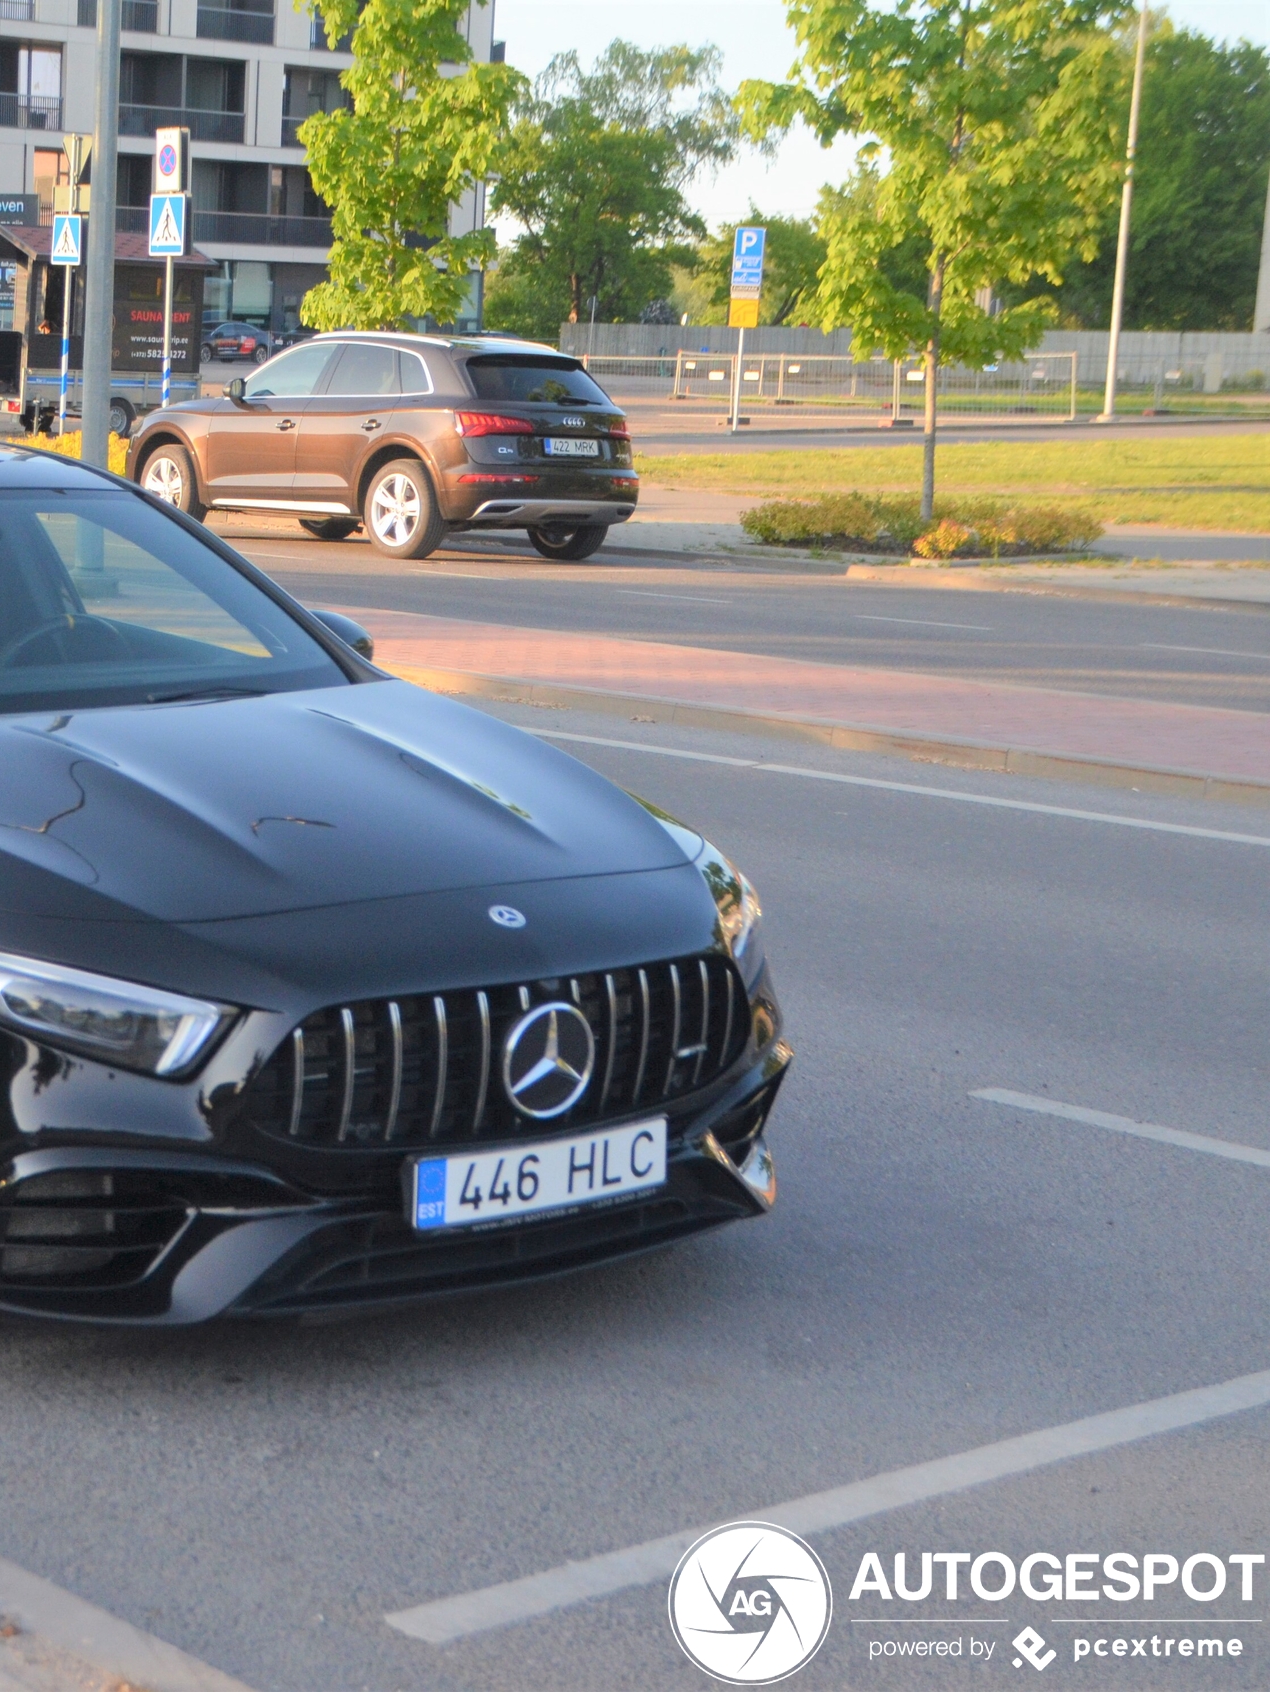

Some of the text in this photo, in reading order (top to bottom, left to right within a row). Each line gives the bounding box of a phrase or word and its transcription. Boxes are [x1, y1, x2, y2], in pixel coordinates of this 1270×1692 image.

[740, 231, 758, 255] P
[131, 310, 191, 323] SAUNA ENT
[131, 335, 189, 346] www.saunrip.ee
[553, 441, 596, 454] 422 MRK
[459, 1130, 654, 1210] 446 HLC
[419, 1201, 444, 1219] EST
